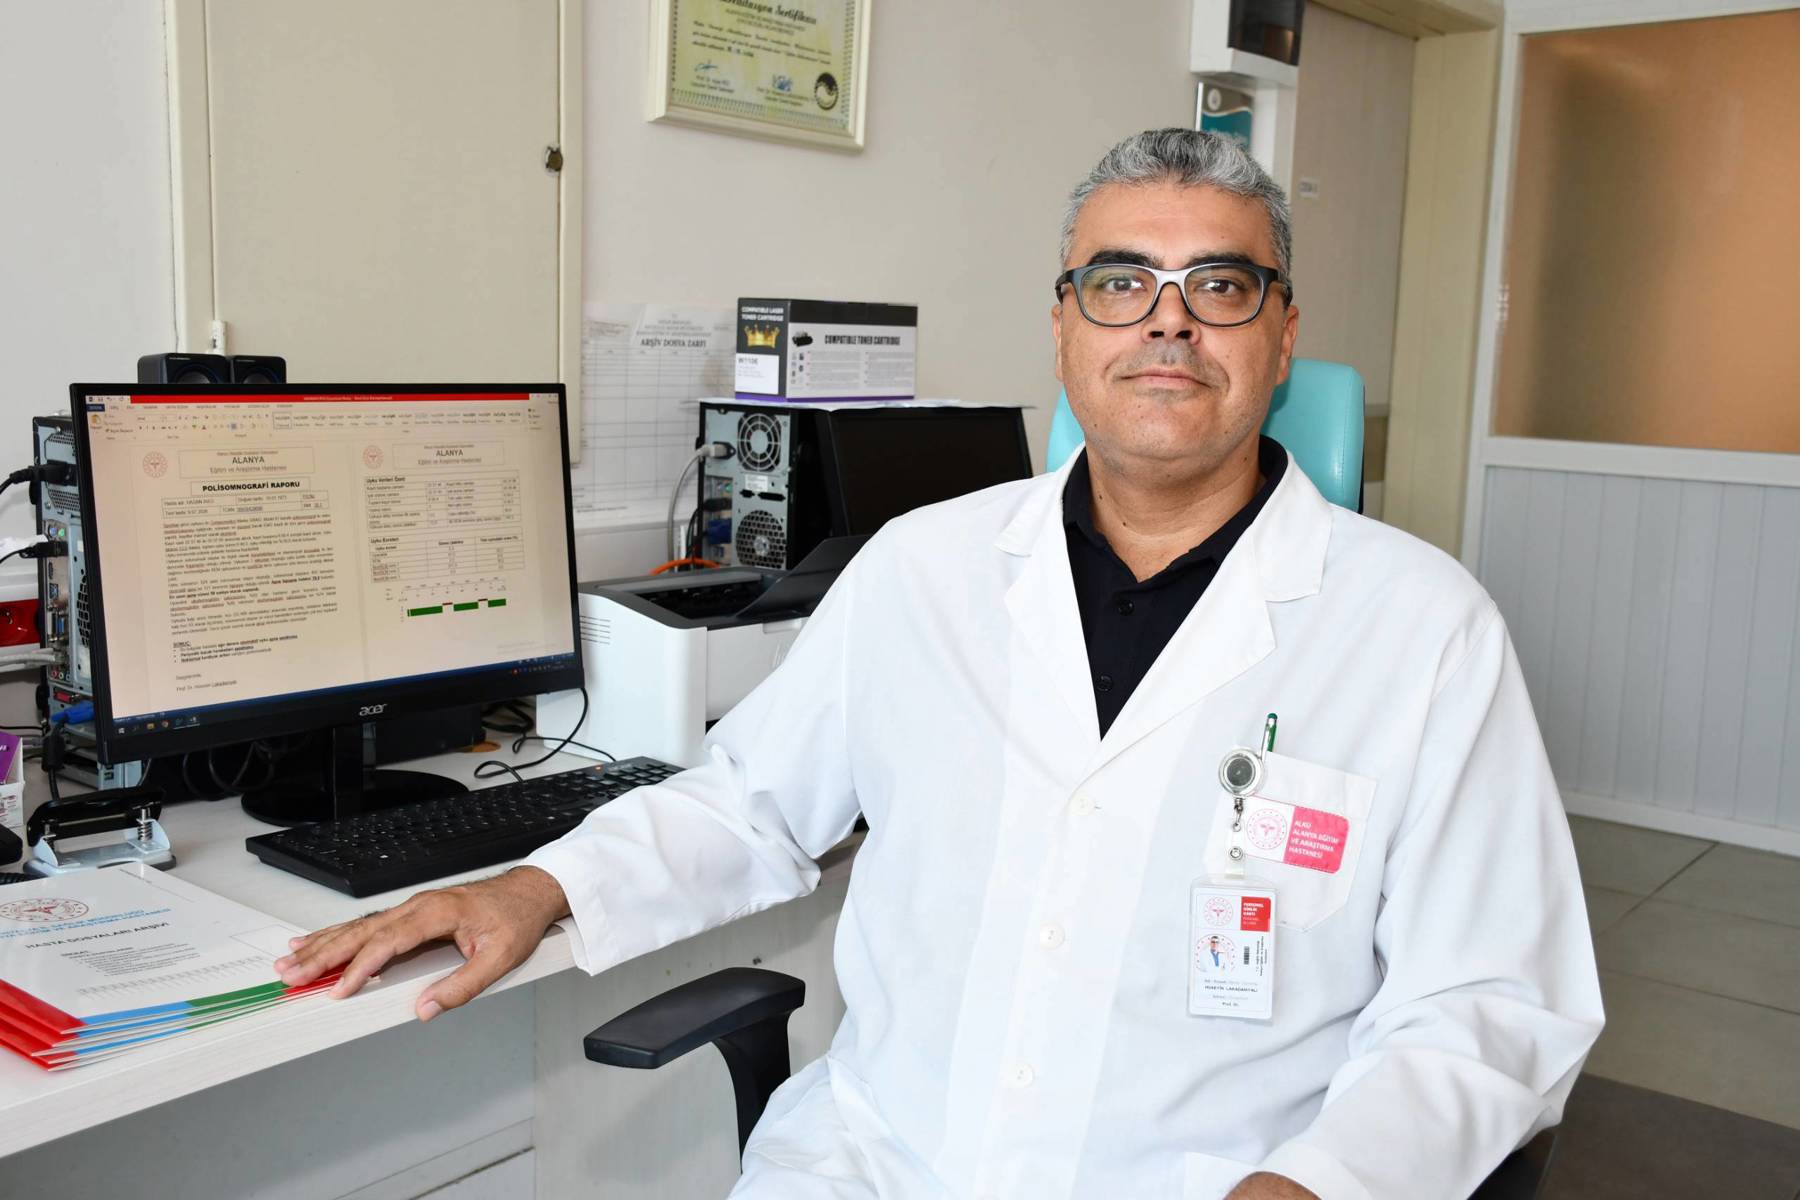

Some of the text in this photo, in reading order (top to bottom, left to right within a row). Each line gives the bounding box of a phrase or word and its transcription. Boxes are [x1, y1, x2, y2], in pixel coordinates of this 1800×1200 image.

[825, 335, 900, 346] COMPATIBLE TONER CARTRIDGE
[232, 456, 265, 464] ALANYA
[202, 481, 300, 492] POLİSOMNOGRAFİ RAPORU
[359, 703, 388, 716] acer
[1293, 829, 1339, 844] ALANYA EĞİTİM
[1300, 839, 1334, 852] ARAŞTIRMA
[1289, 846, 1323, 858] HASTANESİ
[25, 939, 66, 949] HASTA
[67, 929, 134, 944] DOSYALARI
